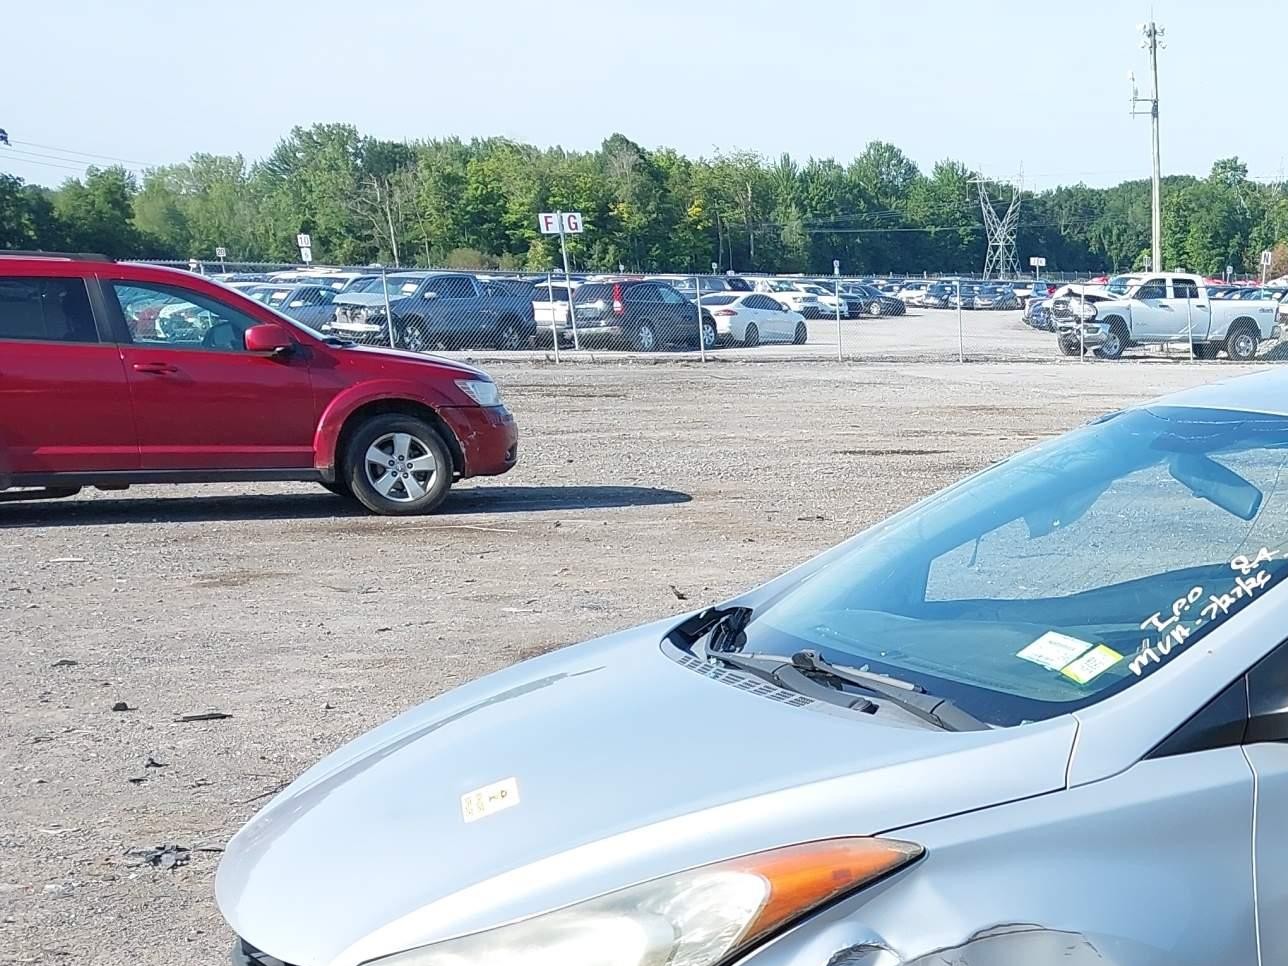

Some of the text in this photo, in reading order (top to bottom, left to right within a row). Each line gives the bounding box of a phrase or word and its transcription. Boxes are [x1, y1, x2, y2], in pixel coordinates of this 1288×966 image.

[543, 214, 579, 231] F G
[299, 236, 310, 245] 10
